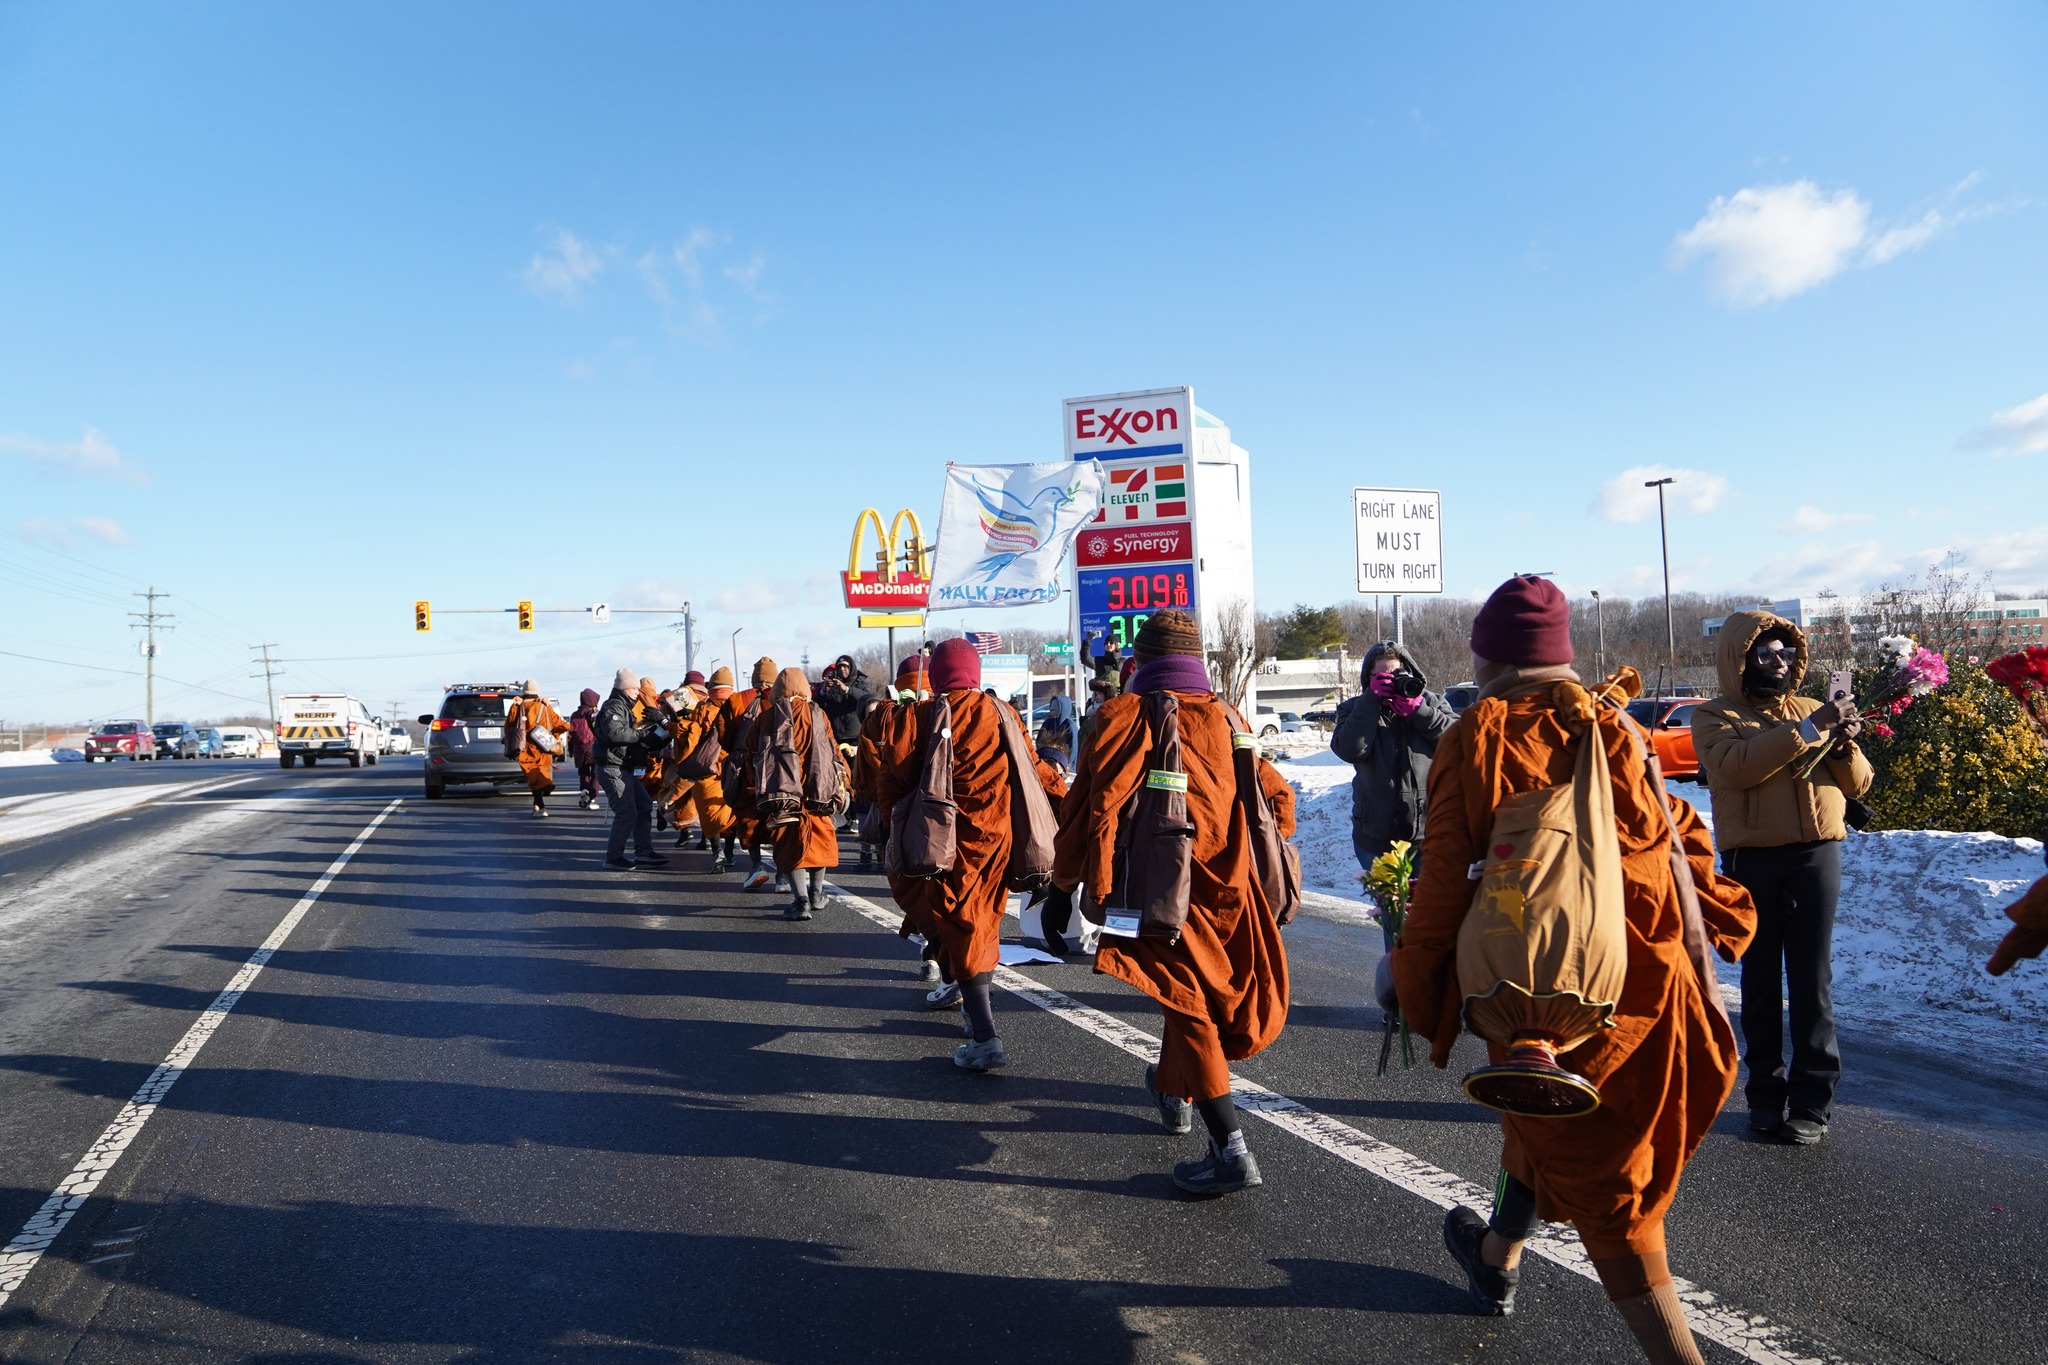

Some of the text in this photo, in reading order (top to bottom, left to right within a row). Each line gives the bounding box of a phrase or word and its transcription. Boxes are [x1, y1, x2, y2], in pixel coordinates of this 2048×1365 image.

[1076, 408, 1178, 445] Exxon
[1360, 502, 1435, 520] RIGHT LANE
[993, 521, 1031, 532] COMPASSION
[1139, 530, 1179, 538] TECHNOLOGY
[985, 526, 1033, 544] LOVING-KINDNESS
[1377, 531, 1421, 550] MUST
[994, 541, 1024, 550] HARMONY
[1113, 537, 1179, 556] Synergy
[1362, 562, 1437, 579] TURN RIGHT
[850, 582, 930, 595] McDonald's
[939, 585, 988, 600] WALK
[1081, 578, 1103, 586] Regular
[1107, 574, 1170, 610] 3.09
[1044, 644, 1060, 653] Town
[983, 658, 1027, 666] FOR LEASE
